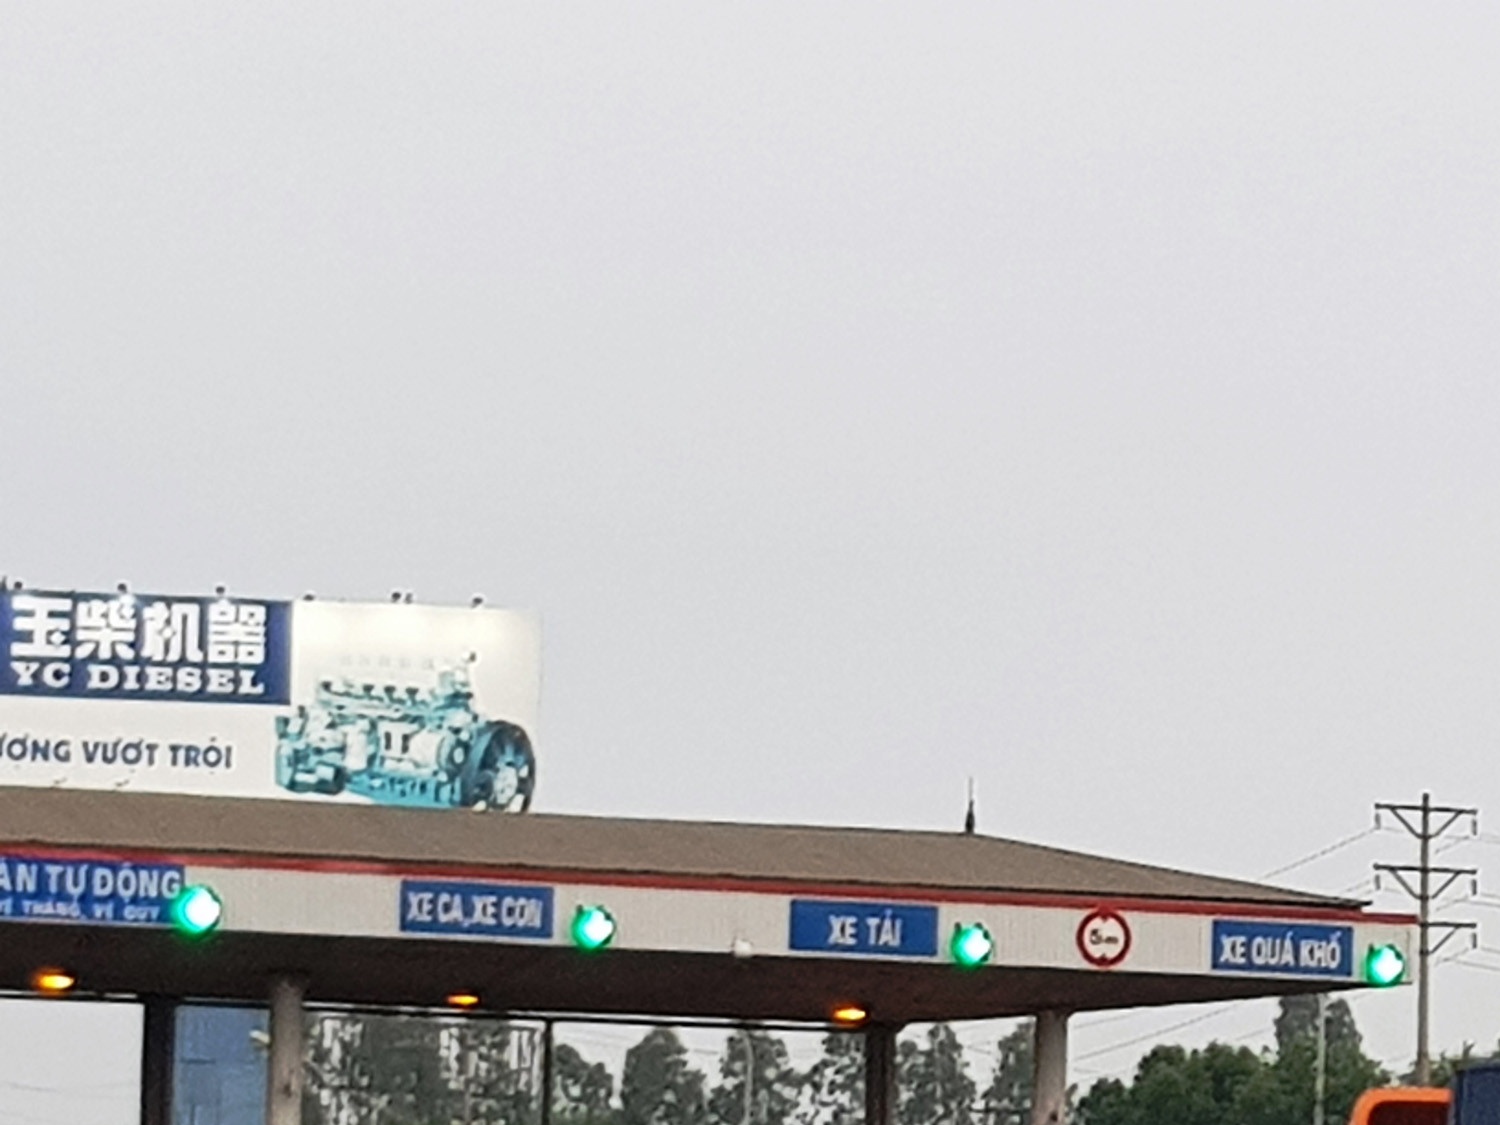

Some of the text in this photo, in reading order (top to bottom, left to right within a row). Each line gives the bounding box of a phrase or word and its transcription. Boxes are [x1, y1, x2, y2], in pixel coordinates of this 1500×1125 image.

[10, 594, 267, 664] 玉柴机器
[10, 662, 265, 695] YC DIESEL
[407, 891, 434, 922] XE
[828, 914, 858, 945] XE
[1220, 934, 1247, 965] XE
[1251, 930, 1296, 966] QUÁ
